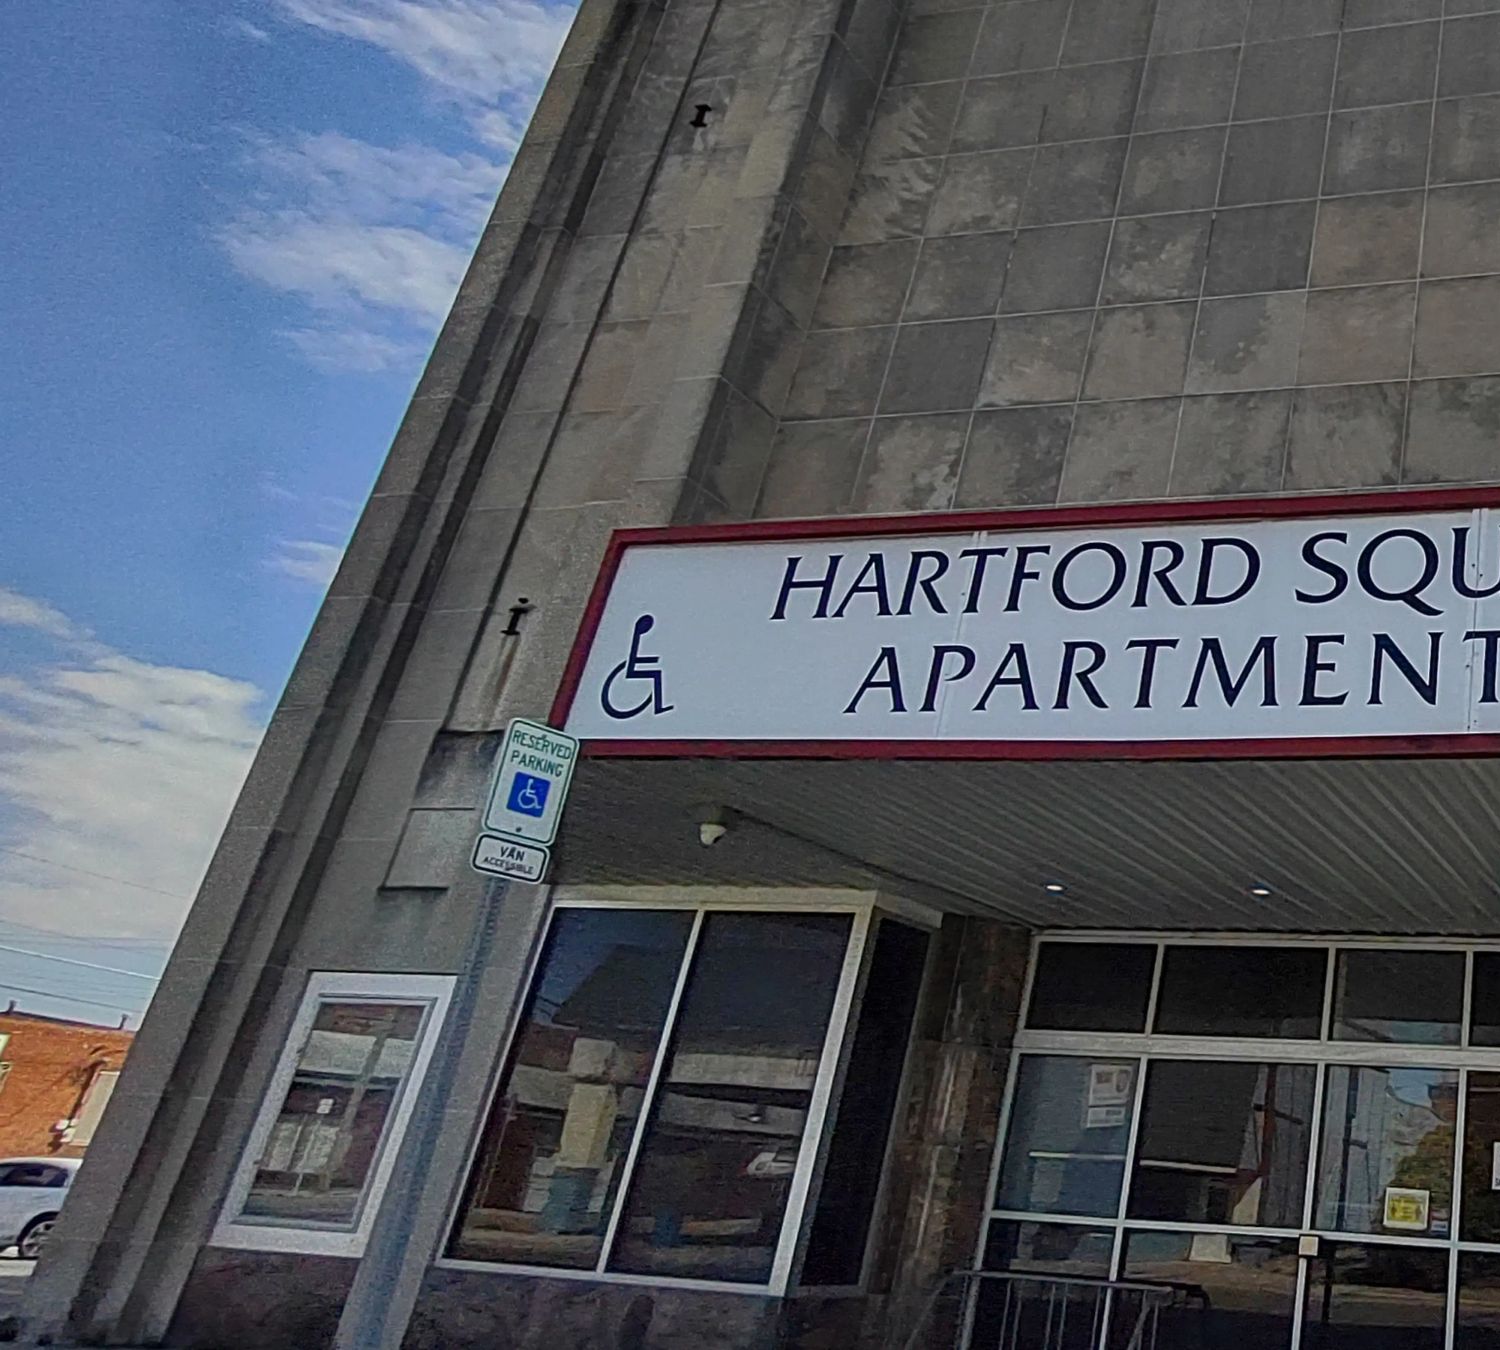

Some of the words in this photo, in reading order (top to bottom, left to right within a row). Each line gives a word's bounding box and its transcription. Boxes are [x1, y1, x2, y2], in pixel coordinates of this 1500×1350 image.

[769, 537, 1261, 620] HARTFORD
[512, 729, 572, 760] RESERVED
[510, 749, 564, 777] PARKING
[500, 846, 525, 862] VAN
